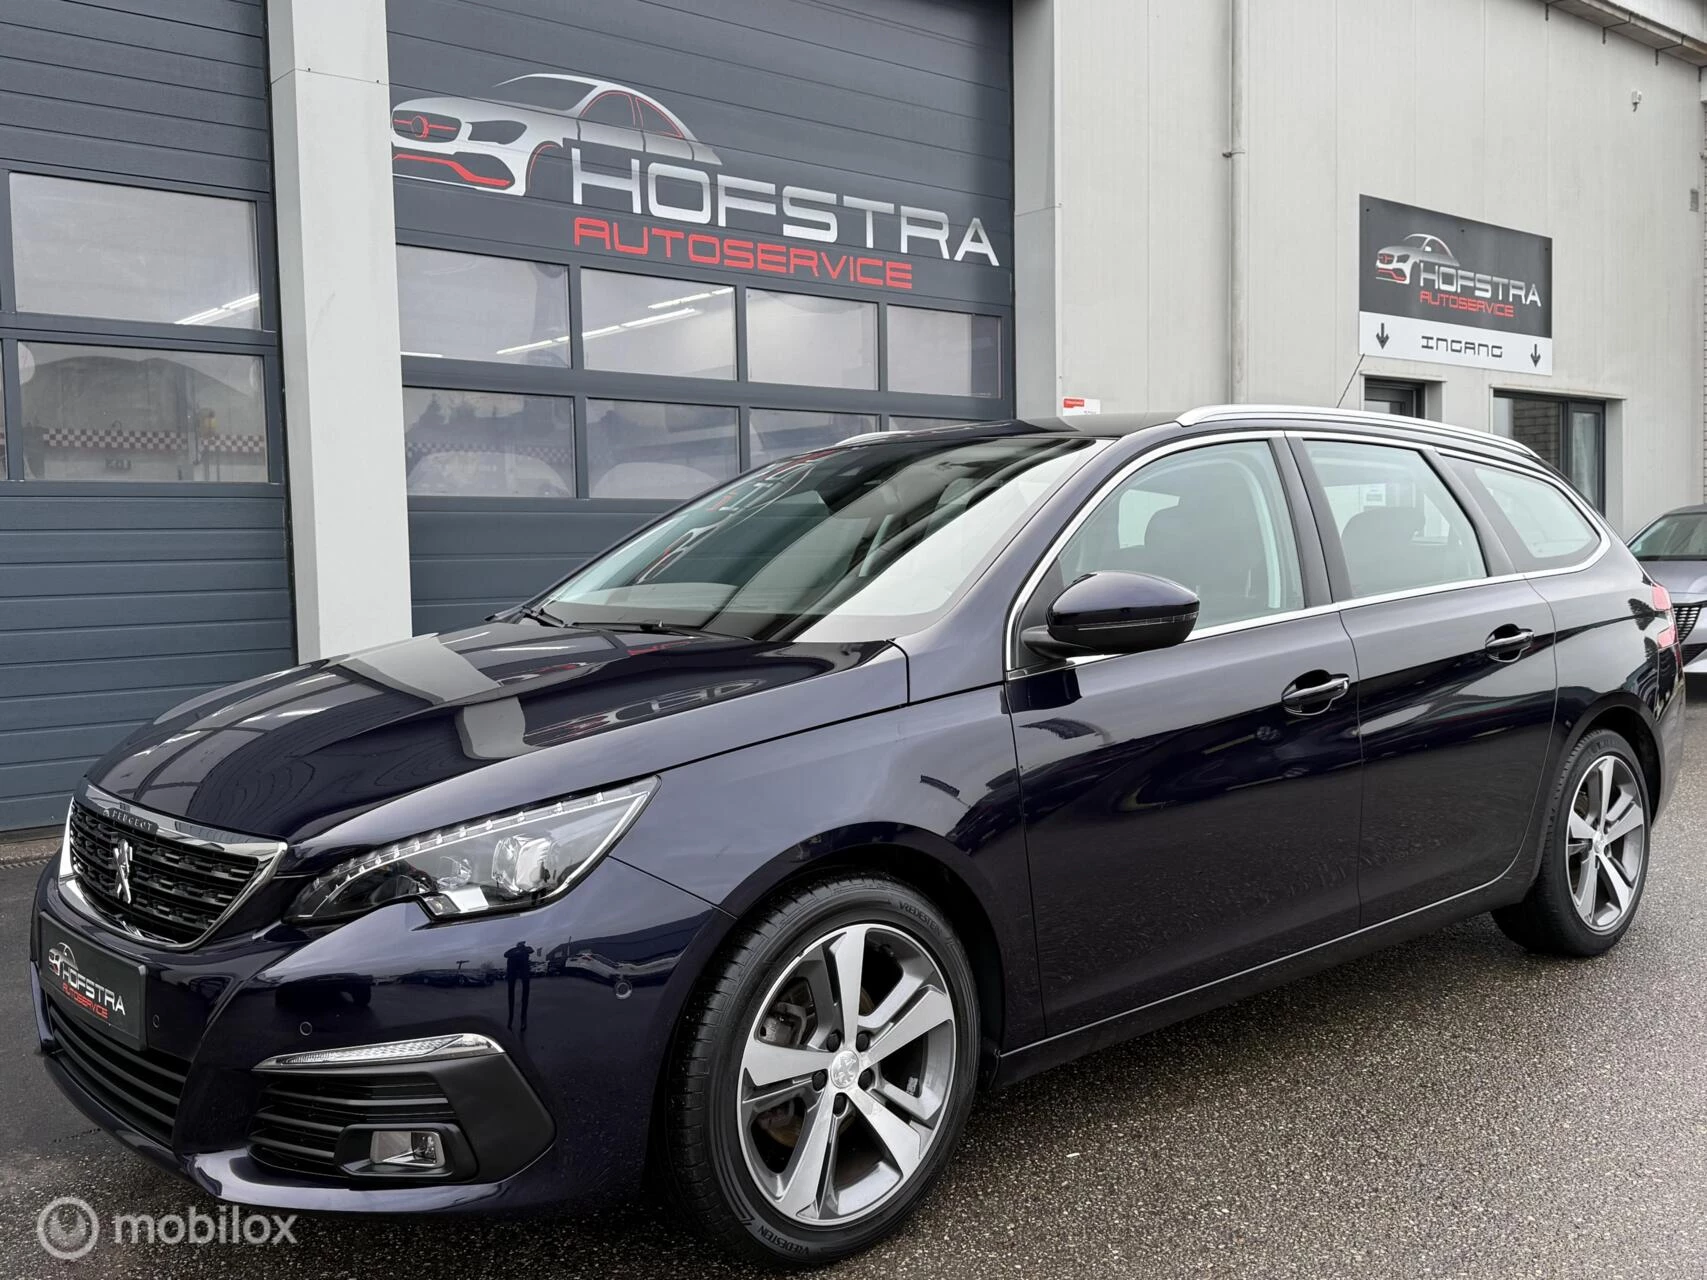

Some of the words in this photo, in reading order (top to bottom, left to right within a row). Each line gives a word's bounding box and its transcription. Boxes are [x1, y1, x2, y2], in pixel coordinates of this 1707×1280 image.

[572, 147, 1000, 267] HOFSTRA
[572, 217, 913, 290] AUTOSERVICE
[1419, 262, 1542, 307] HOFSTRA
[1419, 290, 1515, 318] AUTOSERVICE
[1420, 335, 1503, 358] INGANG
[62, 962, 126, 1016] HOFSTRA
[62, 982, 109, 1019] AUTOSERVICE
